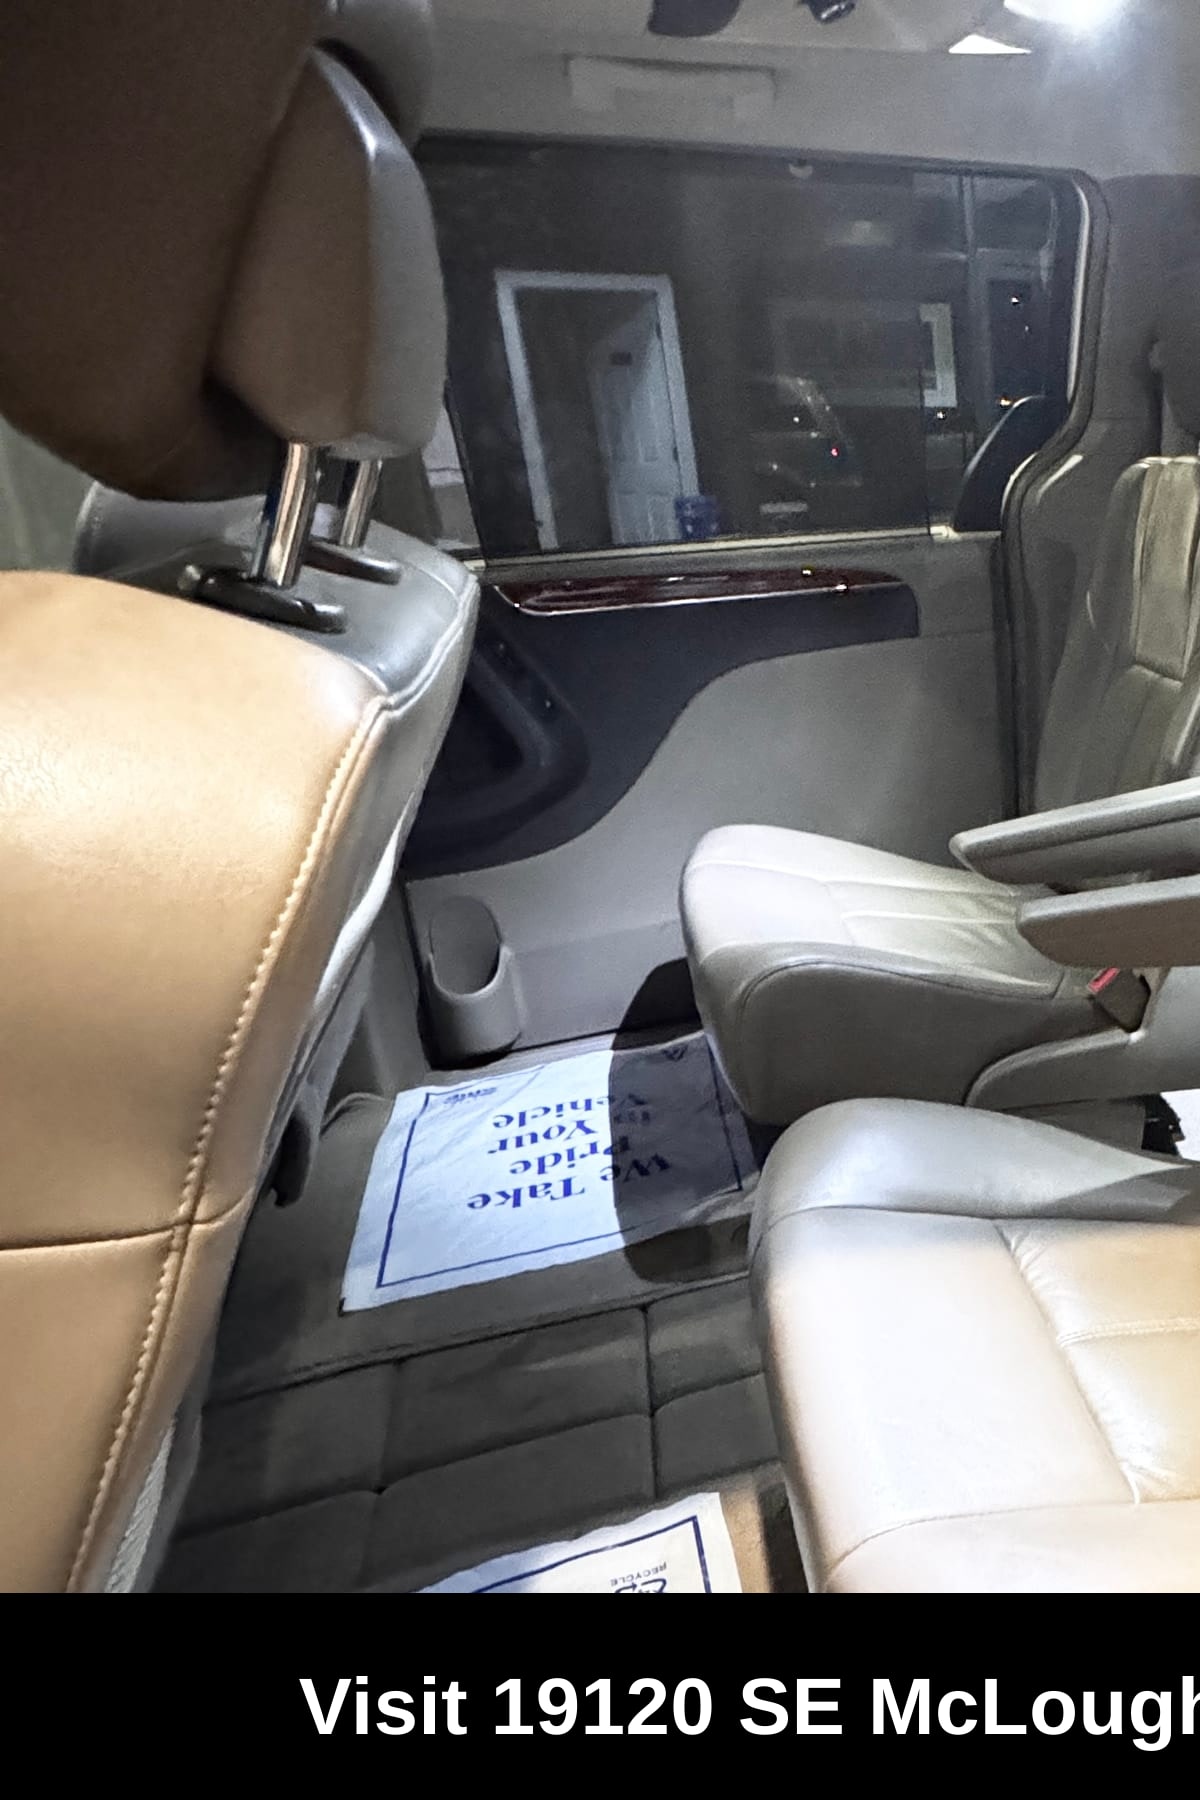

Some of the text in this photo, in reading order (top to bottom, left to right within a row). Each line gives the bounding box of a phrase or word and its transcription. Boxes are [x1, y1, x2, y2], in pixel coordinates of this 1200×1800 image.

[492, 1093, 647, 1129] Vehicle
[487, 1119, 599, 1154] Your
[509, 1135, 631, 1176] Pride
[467, 1153, 672, 1210] We Take
[610, 1561, 667, 1587] RECYCLE
